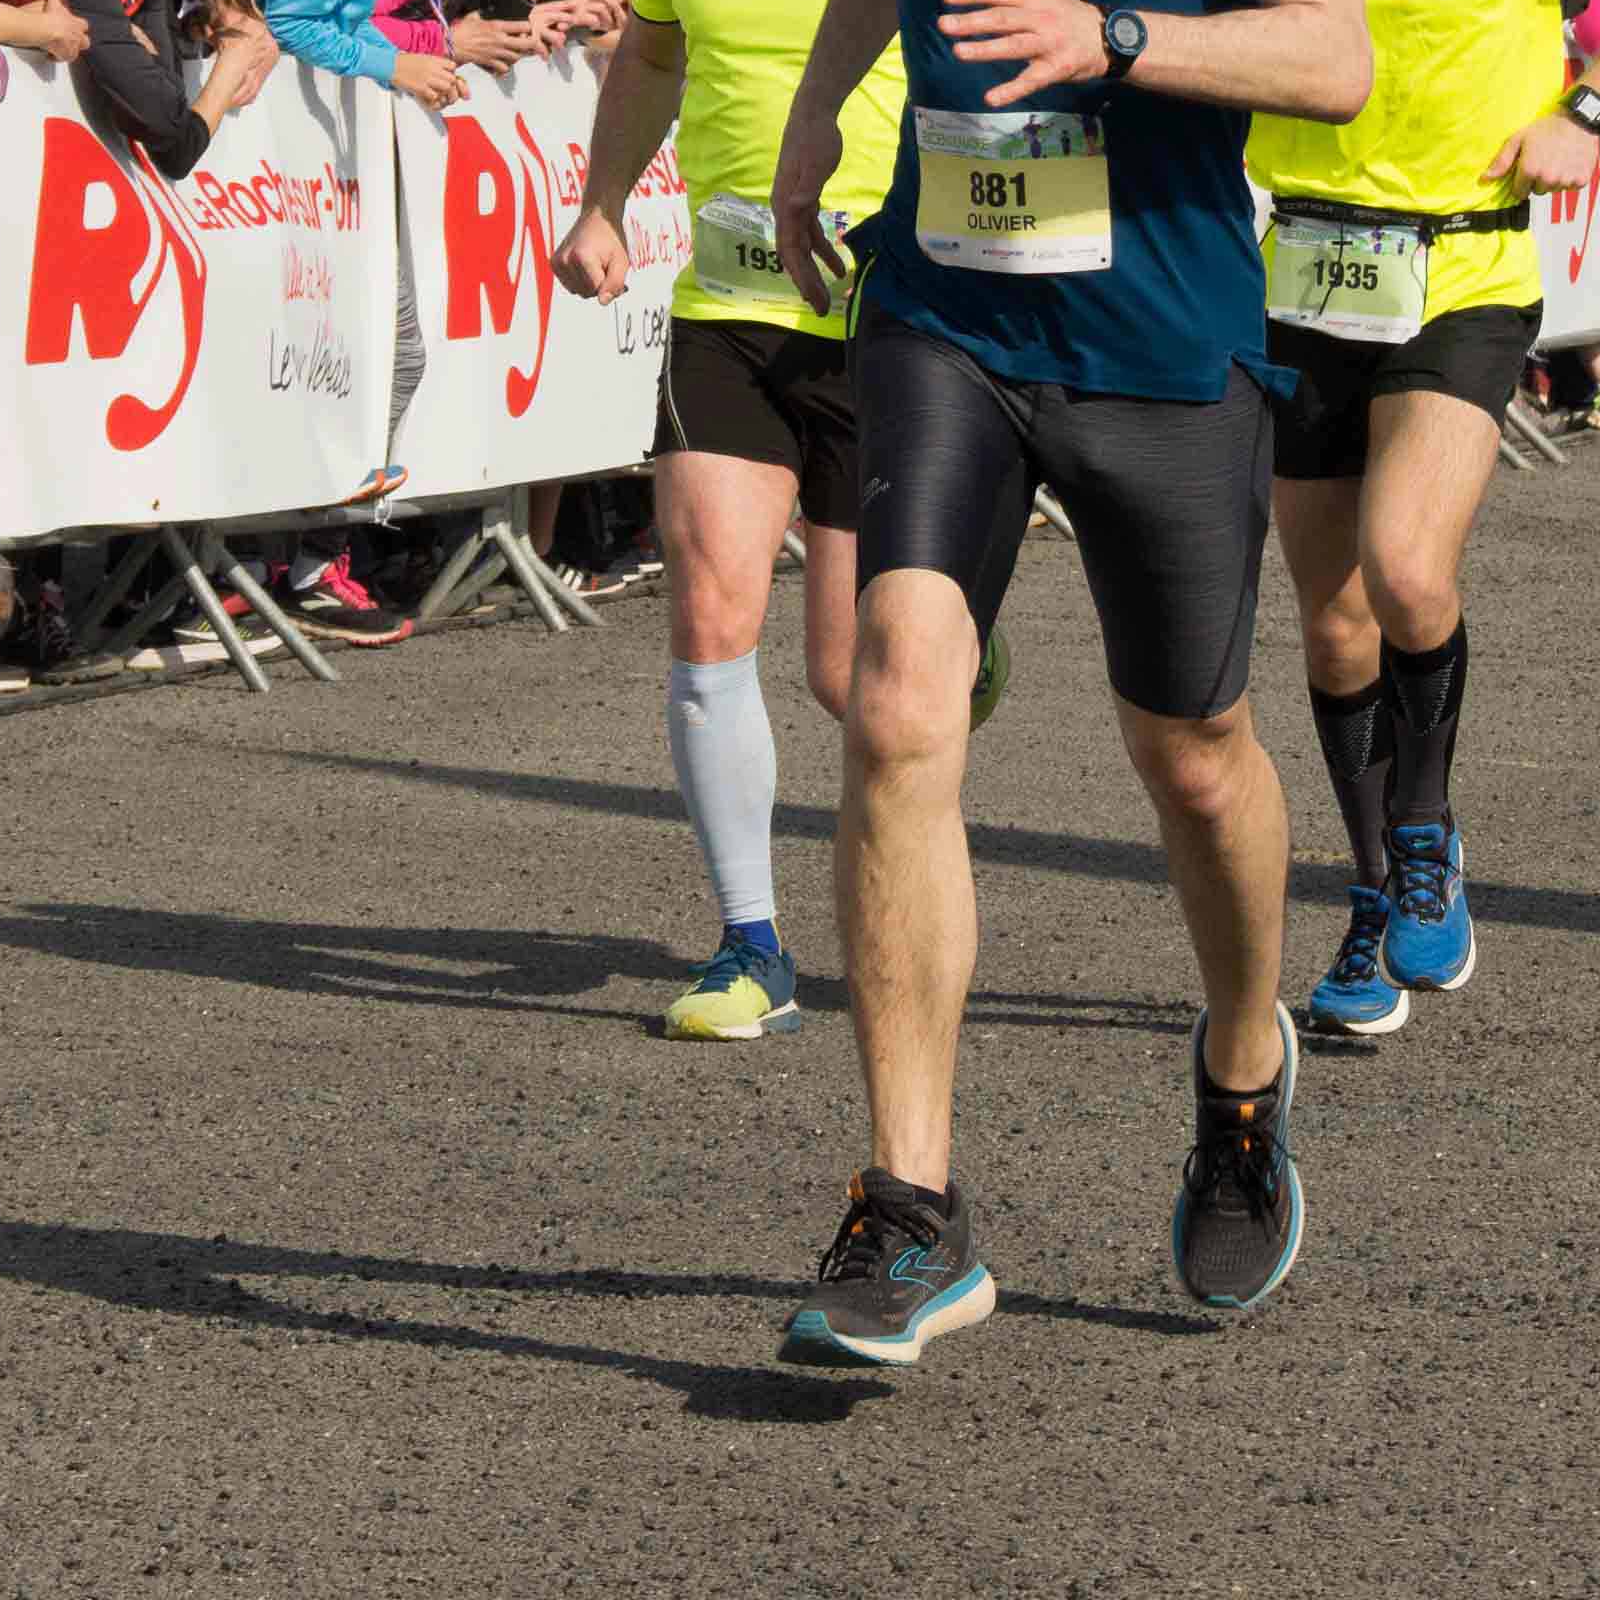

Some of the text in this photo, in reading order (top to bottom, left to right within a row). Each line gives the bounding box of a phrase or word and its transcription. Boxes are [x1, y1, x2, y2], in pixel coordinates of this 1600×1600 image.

[969, 170, 1028, 207] 881
[967, 213, 1037, 232] OLIVIER
[735, 242, 784, 275] 193
[1313, 259, 1379, 291] 1935
